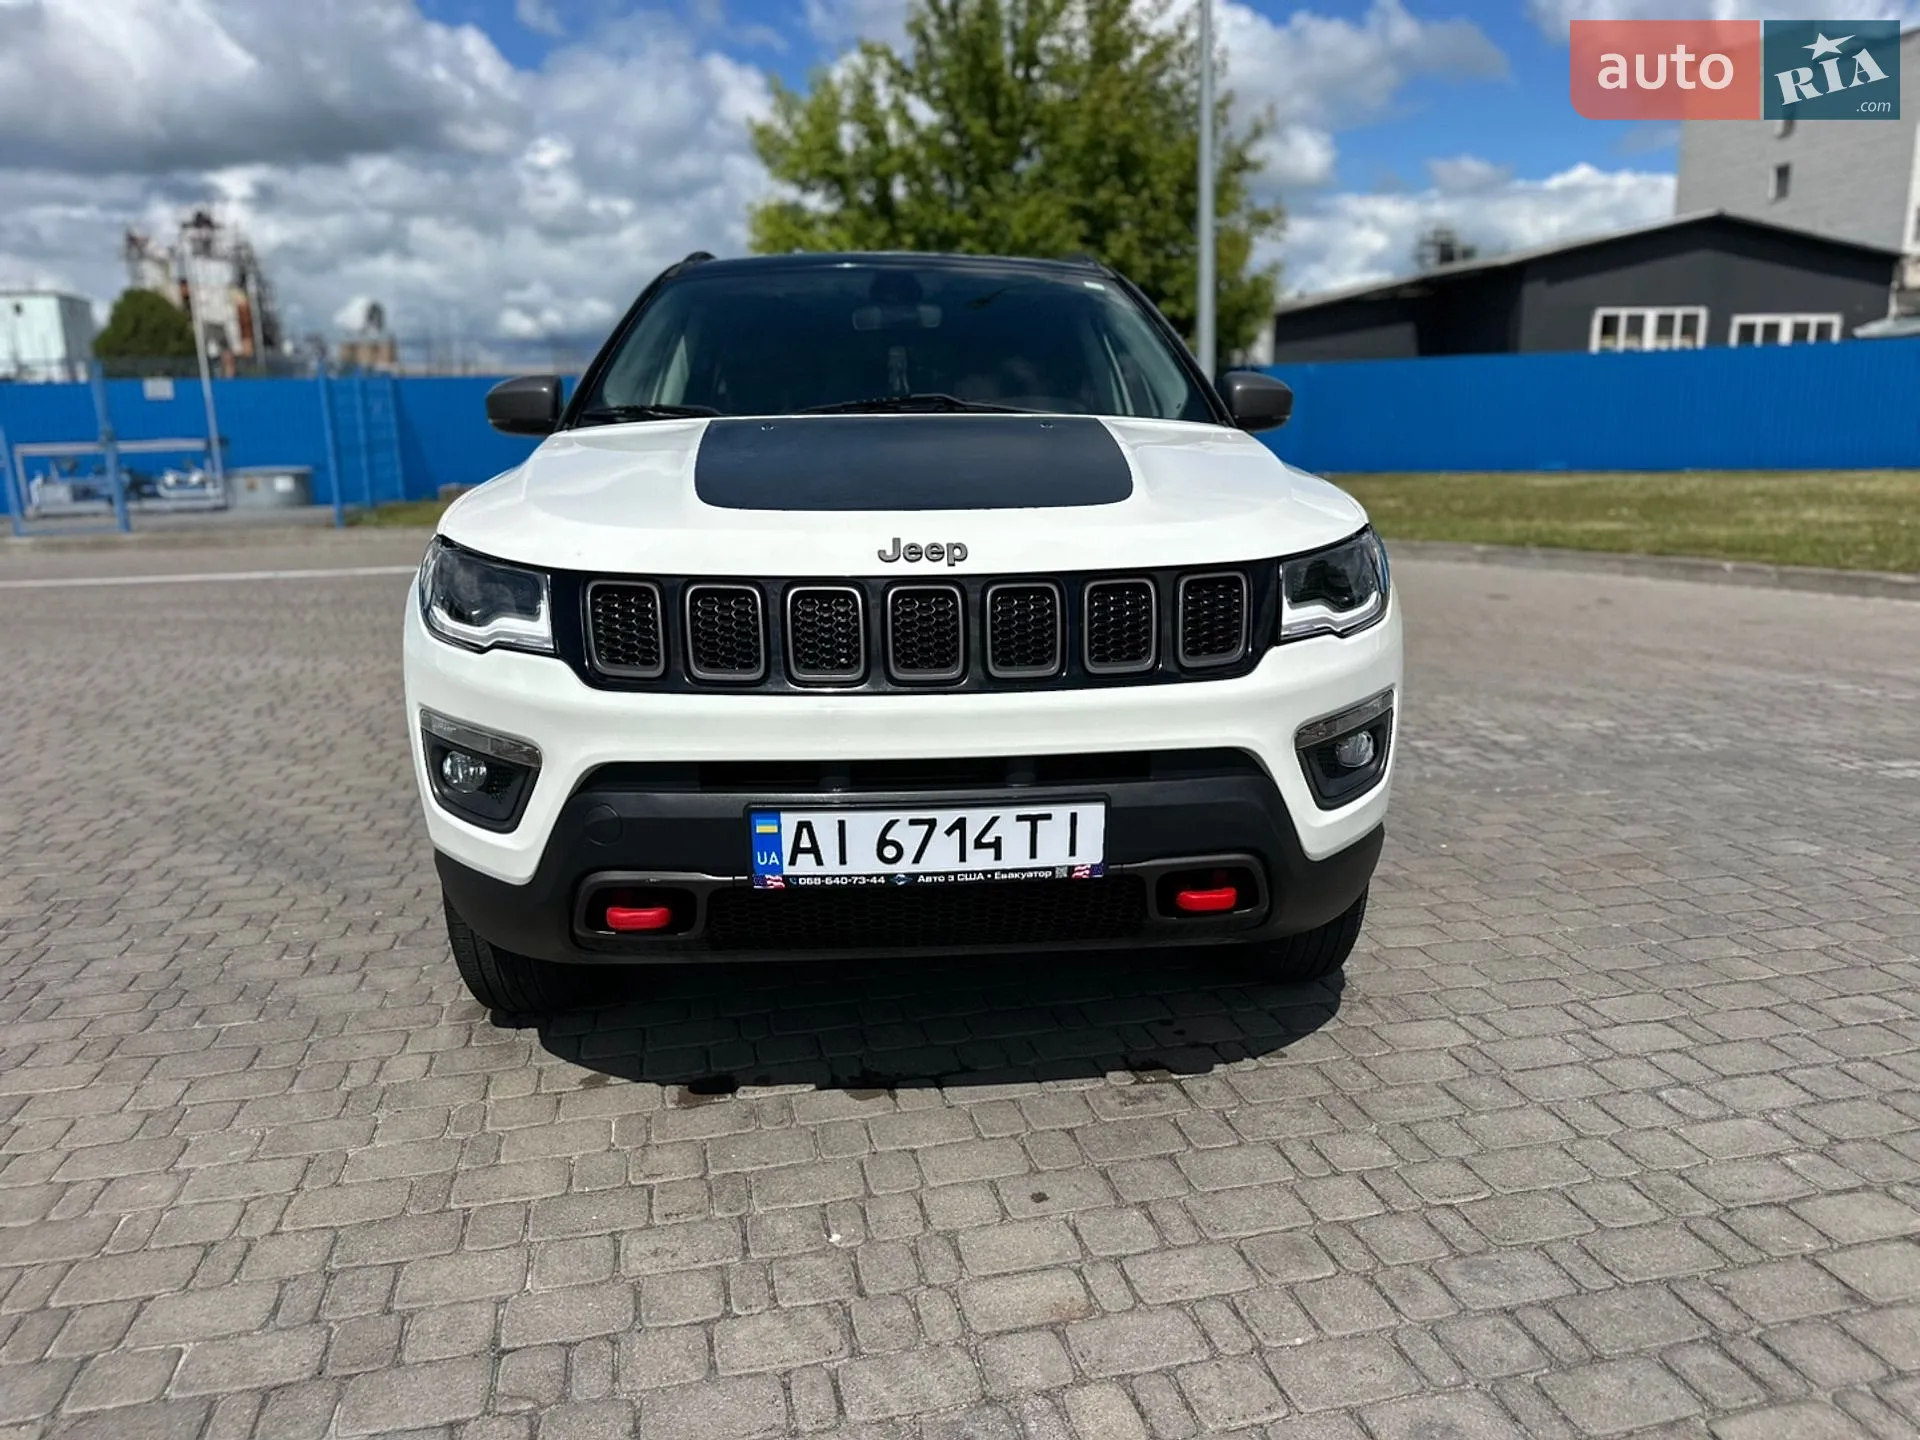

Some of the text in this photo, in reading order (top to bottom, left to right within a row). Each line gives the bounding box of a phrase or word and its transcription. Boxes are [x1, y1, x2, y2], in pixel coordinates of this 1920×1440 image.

[877, 537, 968, 567] Jeep
[788, 811, 1078, 866] AI 6714 TI
[757, 851, 780, 866] UA
[917, 874, 945, 883] Авто
[957, 872, 985, 882] США
[994, 870, 1052, 880] Евакуатор
